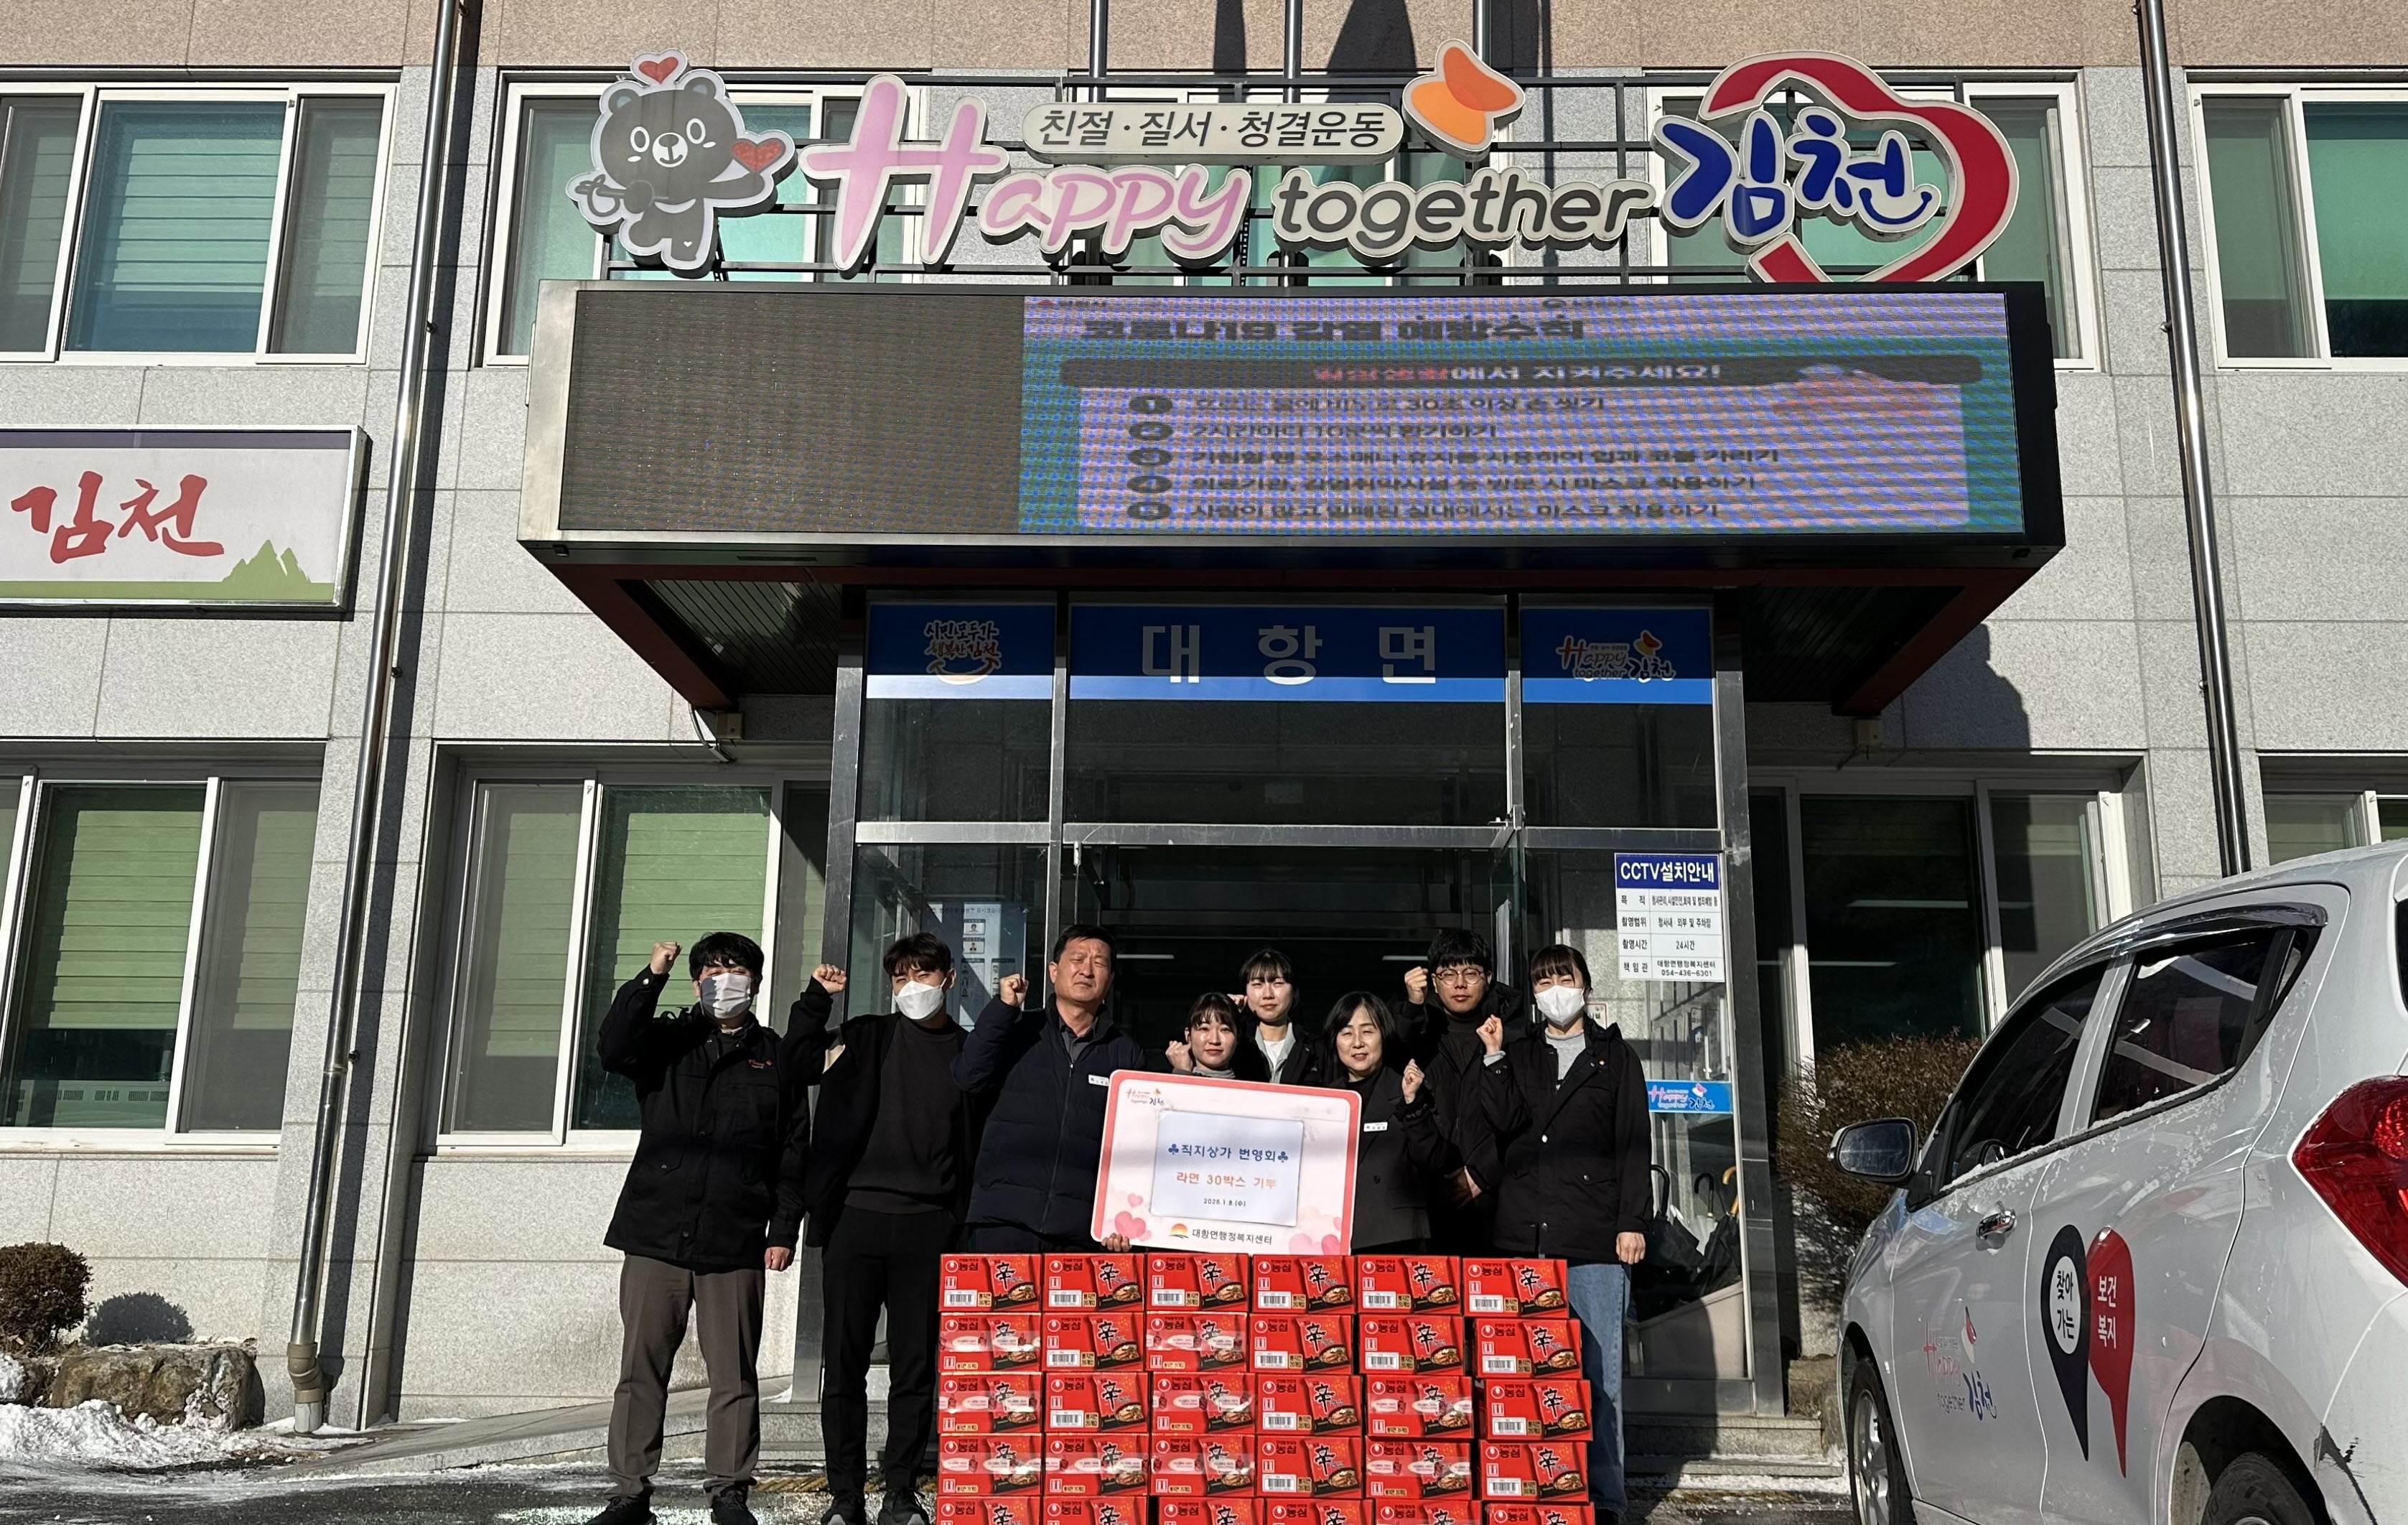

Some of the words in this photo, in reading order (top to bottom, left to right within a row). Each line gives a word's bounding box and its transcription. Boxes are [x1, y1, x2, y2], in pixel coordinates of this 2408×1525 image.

[804, 75, 1246, 264] Happy
[1280, 174, 1647, 248] together
[1661, 114, 1933, 236] 김천
[11, 471, 225, 564] 김천
[1557, 636, 1627, 668] Happy
[1574, 668, 1625, 679] together
[1620, 862, 1715, 884] CCTV설치안내
[1676, 940, 1695, 951] 24시간
[1176, 1172, 1200, 1185] 라면
[1206, 1175, 1246, 1188] 30박스
[1254, 1177, 1277, 1190] 기부
[1191, 1228, 1273, 1246] 대항면행정복지센터
[2056, 1271, 2073, 1302] 찾아
[2098, 1275, 2118, 1308] 보건
[2056, 1308, 2075, 1340] 가는
[2098, 1315, 2117, 1350] 복지
